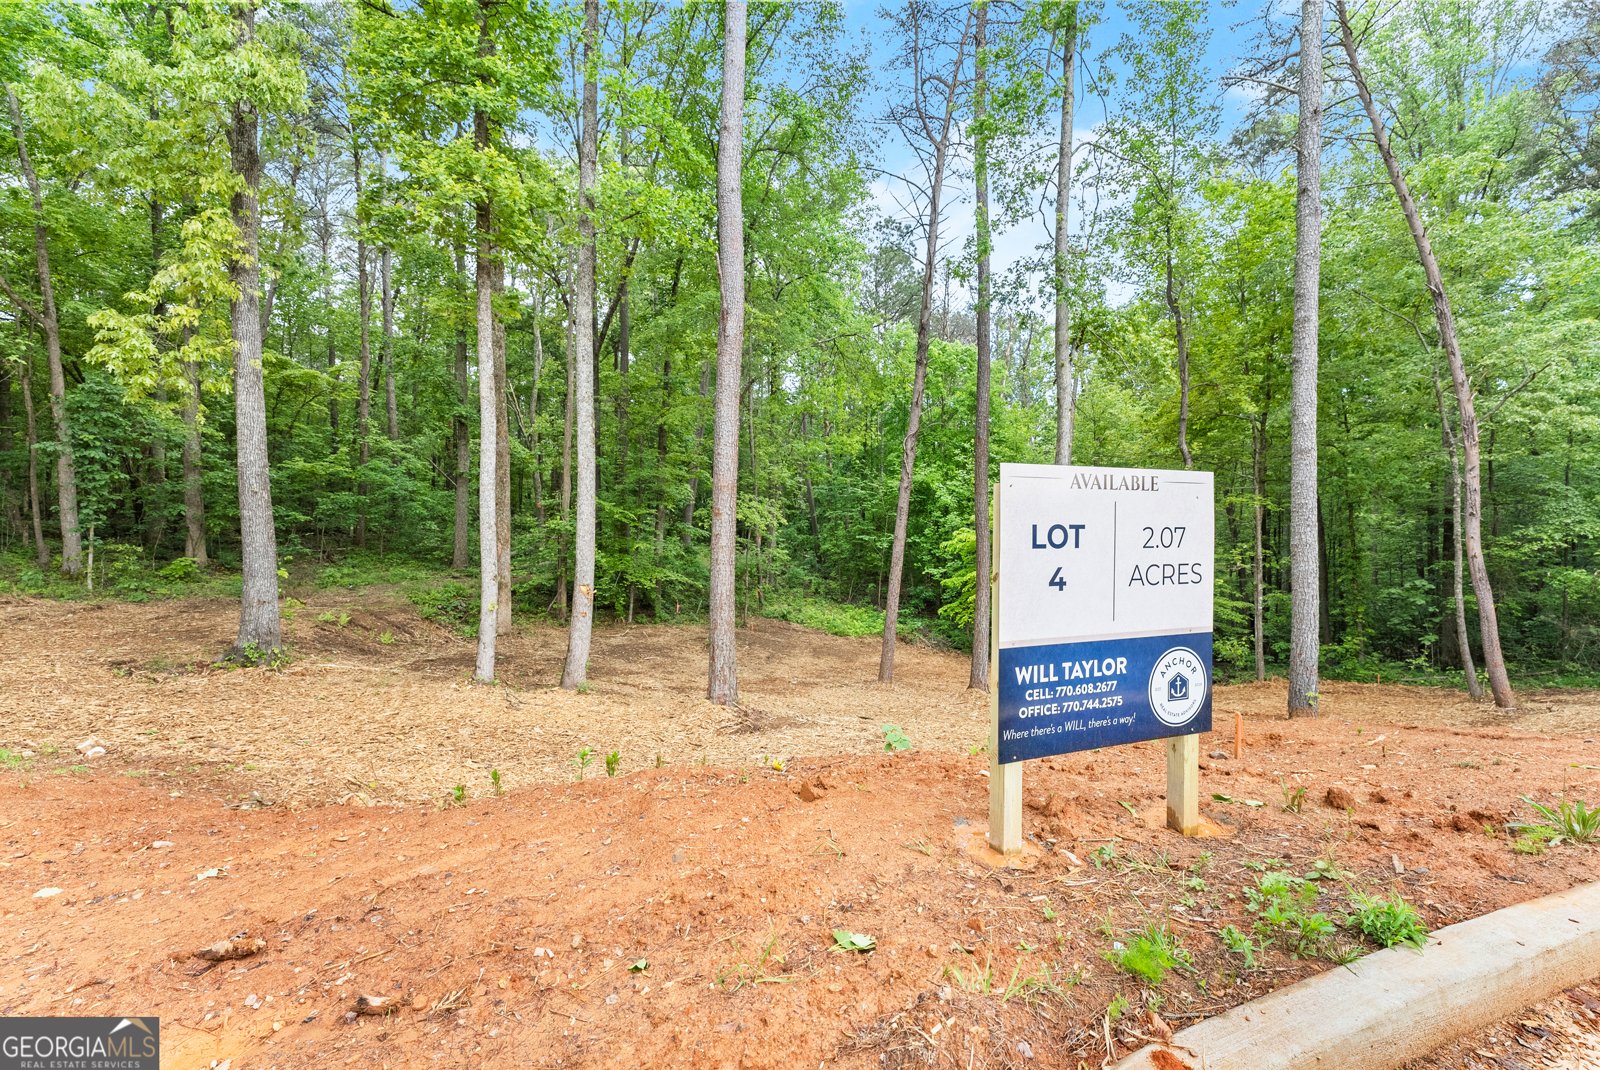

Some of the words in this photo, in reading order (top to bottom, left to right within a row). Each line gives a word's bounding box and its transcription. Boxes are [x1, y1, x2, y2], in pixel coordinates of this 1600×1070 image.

[1070, 473, 1159, 491] AVAILABLE
[1032, 524, 1085, 549] LOT
[1142, 527, 1186, 549] 2.07
[1048, 567, 1067, 591] 4
[1128, 563, 1202, 587] ACRES
[1015, 663, 1059, 685] WILL
[1062, 657, 1127, 680] TAYLOR
[1160, 657, 1197, 678] ANCHOR
[1025, 688, 1053, 701] CELL:
[1055, 680, 1118, 699] 770.608.2677
[1019, 704, 1060, 719] OFFICE:
[1062, 696, 1123, 714] 770.744.2575
[1003, 729, 1028, 741] Where
[1030, 724, 1055, 736] there's
[1064, 720, 1086, 732] WILL,
[1088, 716, 1111, 728] there's
[1119, 712, 1136, 726] way!
